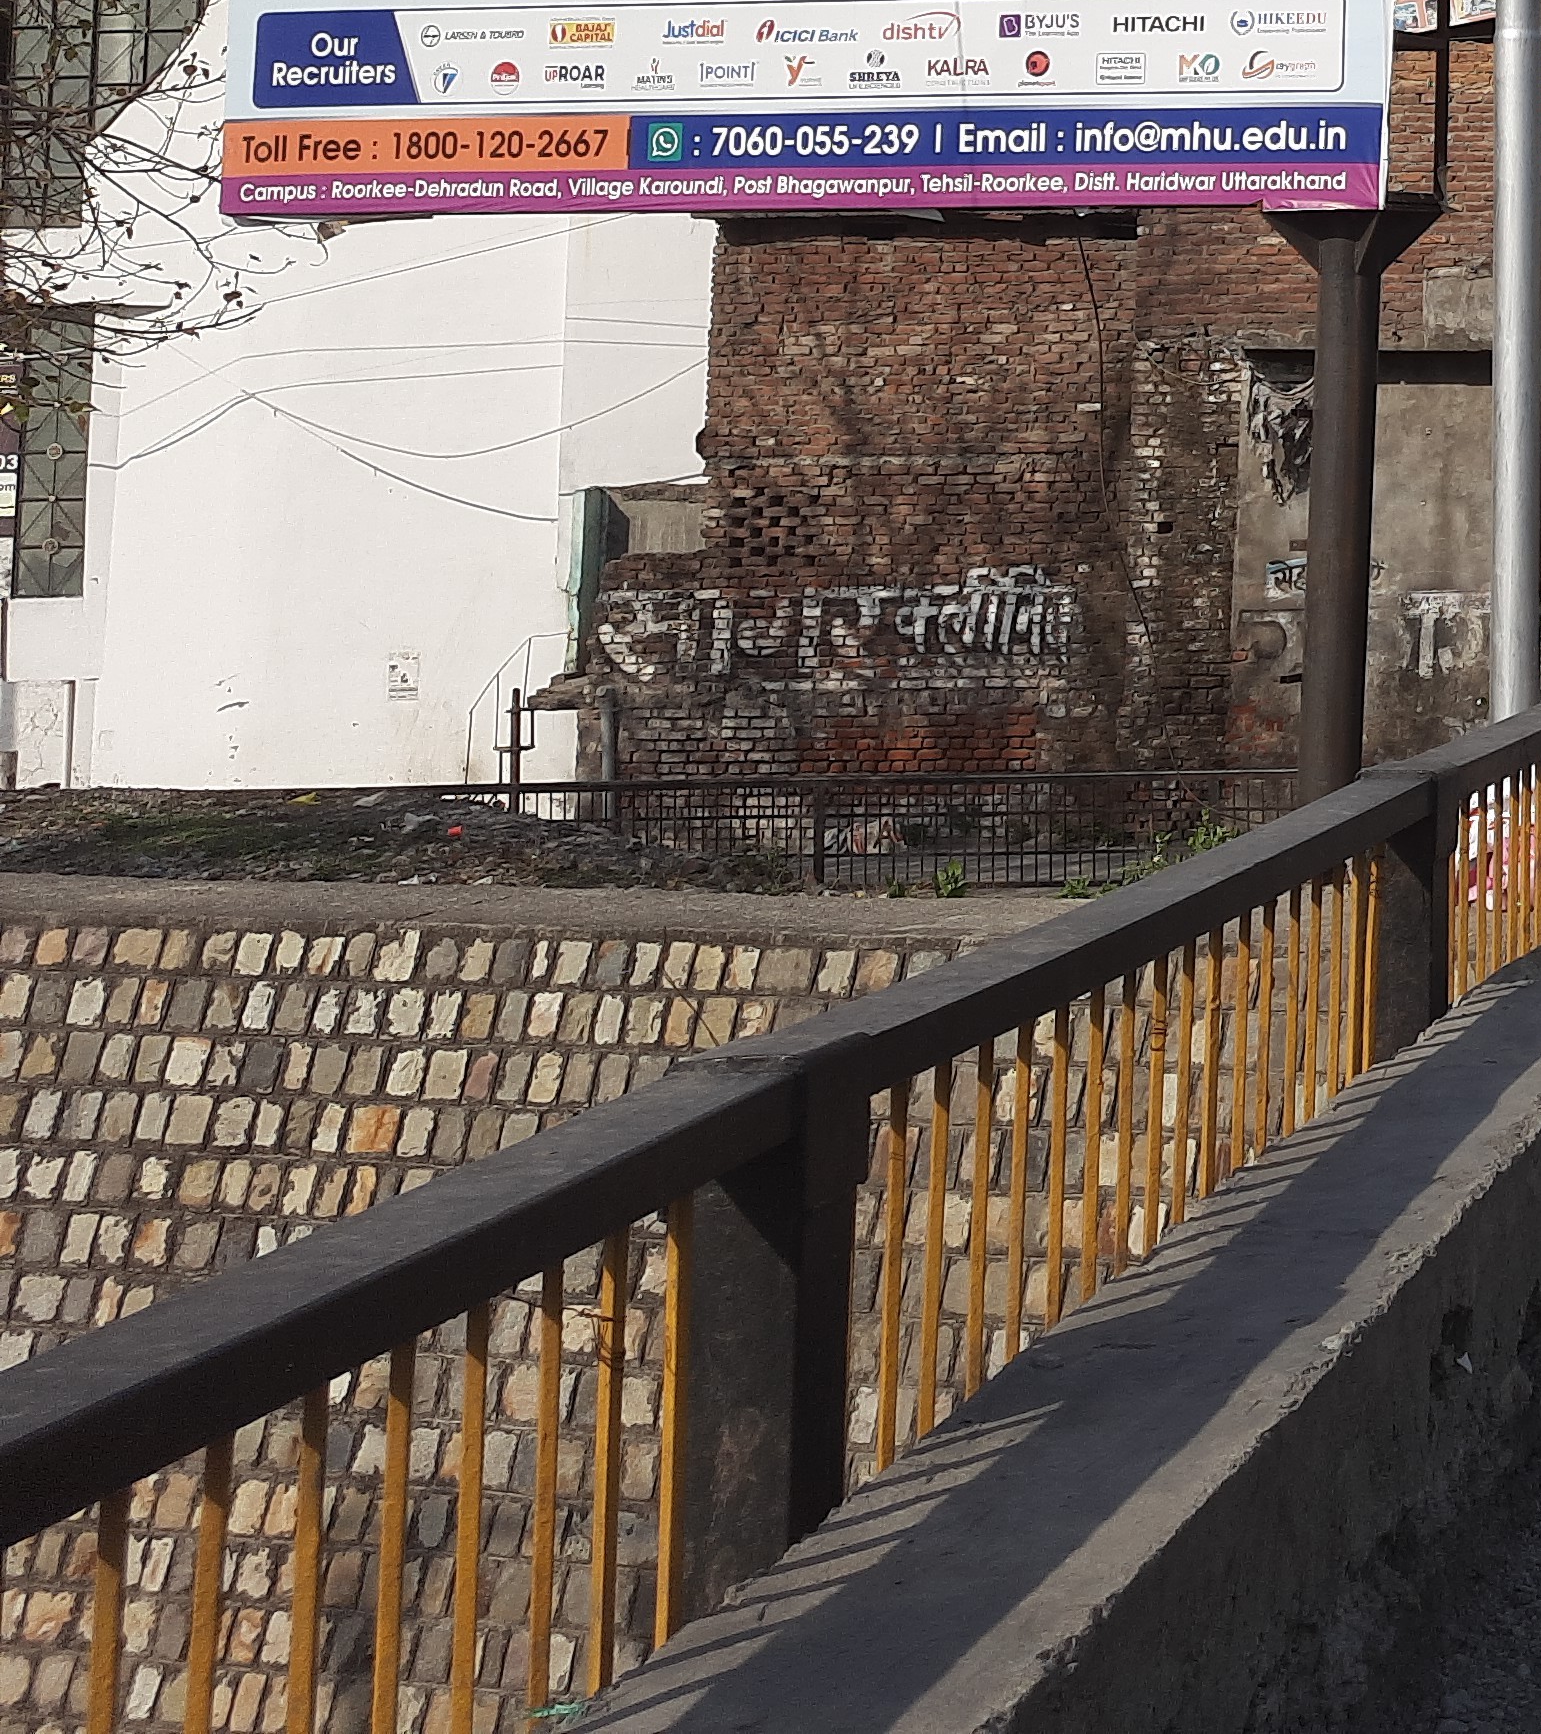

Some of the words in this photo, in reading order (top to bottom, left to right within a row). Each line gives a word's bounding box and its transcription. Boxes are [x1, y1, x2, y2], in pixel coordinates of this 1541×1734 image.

[1025, 14, 1080, 29] BYJU'S
[1112, 16, 1205, 33] HITACHI
[1257, 12, 1328, 26] HIKEEDU
[662, 20, 725, 40] Justdial
[774, 29, 816, 44] ICICI
[818, 28, 860, 43] Bank
[310, 32, 358, 58] Our
[272, 59, 396, 89] Recruiters
[848, 70, 901, 82] SHREYA
[927, 58, 989, 77] KALRA
[243, 134, 287, 164] Toll
[297, 133, 361, 161] Free
[391, 129, 609, 160] 1800-120-2667
[711, 124, 919, 157] 7060-055-239
[959, 123, 1047, 154] Email
[1074, 120, 1347, 155] info@mhu.edu.in
[239, 183, 316, 205] Campus
[331, 177, 504, 201] Roorkee-Dehradun
[510, 177, 562, 202] Road,
[567, 175, 633, 201] Village
[638, 173, 728, 198] Karoundi,
[734, 173, 772, 196] Post
[777, 172, 917, 199] Bhagawanpur,
[921, 171, 1069, 195] Tehsil-Roorkee,
[1074, 170, 1120, 193] Distt.
[1126, 170, 1215, 191] Haridwar
[1221, 169, 1347, 191] Uttarakhand
